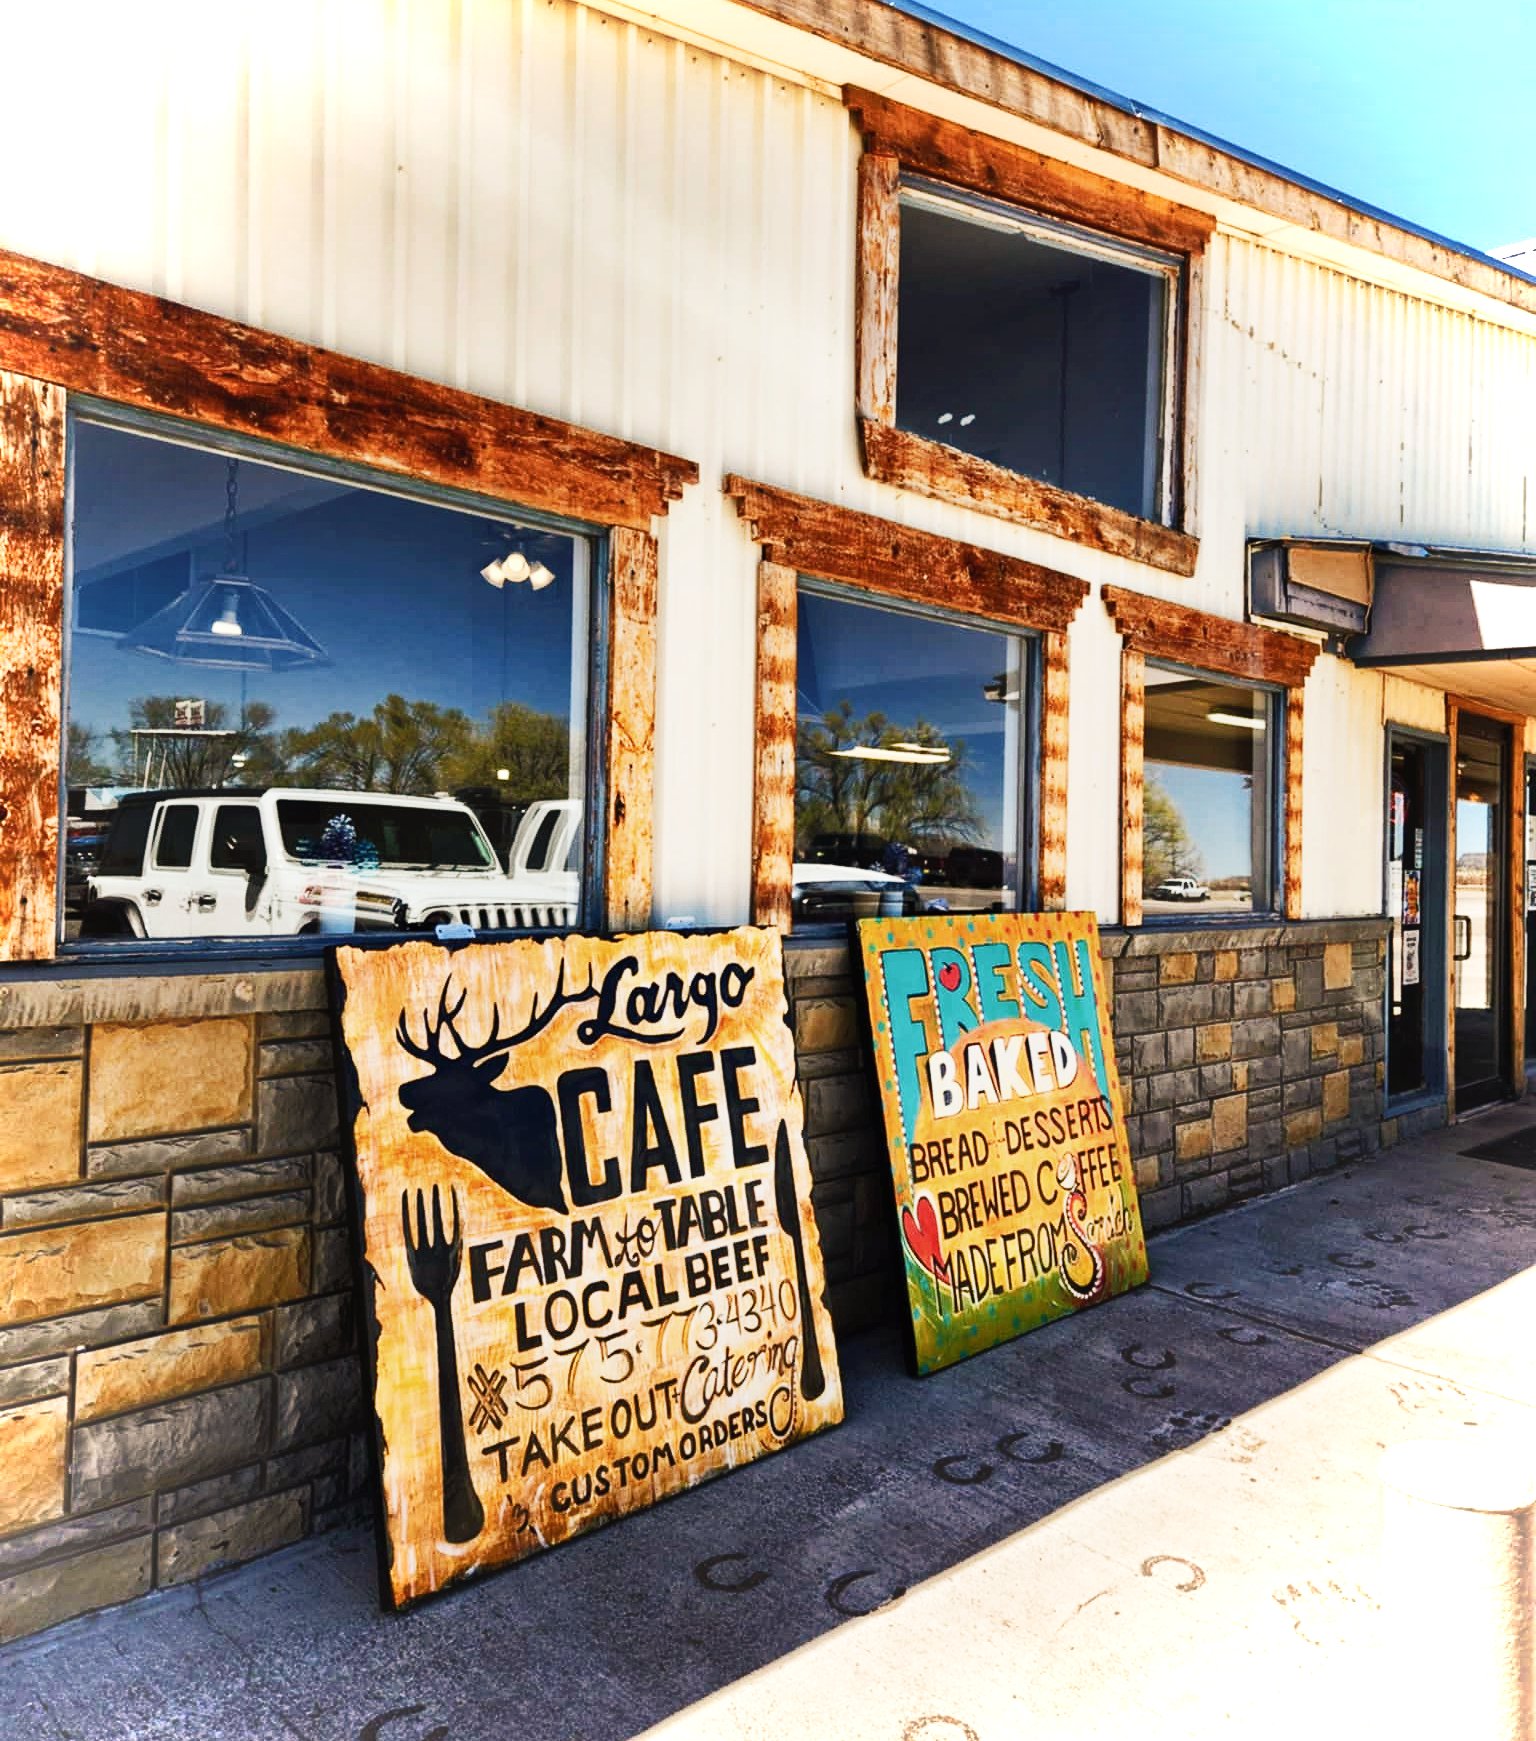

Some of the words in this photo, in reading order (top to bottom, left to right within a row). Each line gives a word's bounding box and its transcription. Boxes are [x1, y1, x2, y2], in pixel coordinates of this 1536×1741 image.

[577, 955, 755, 1046] Largo
[878, 939, 1111, 1150] FRESH
[556, 1046, 769, 1207] CAFE
[928, 1030, 1078, 1121] BAKED
[909, 1130, 990, 1184] BREAD
[1004, 1095, 1113, 1156] DESSERTS
[469, 1216, 614, 1303] FARM
[614, 1216, 659, 1268] to
[655, 1179, 769, 1252] TABLE
[936, 1170, 1031, 1240] BREWED
[514, 1262, 680, 1354] LOCAL
[684, 1239, 770, 1298] BEEF
[930, 1237, 1004, 1318] MADE
[1003, 1212, 1068, 1291] FROM
[679, 1330, 800, 1438] Catering
[549, 1441, 677, 1514] CUSTOM
[678, 1398, 768, 1462] ORDERS
